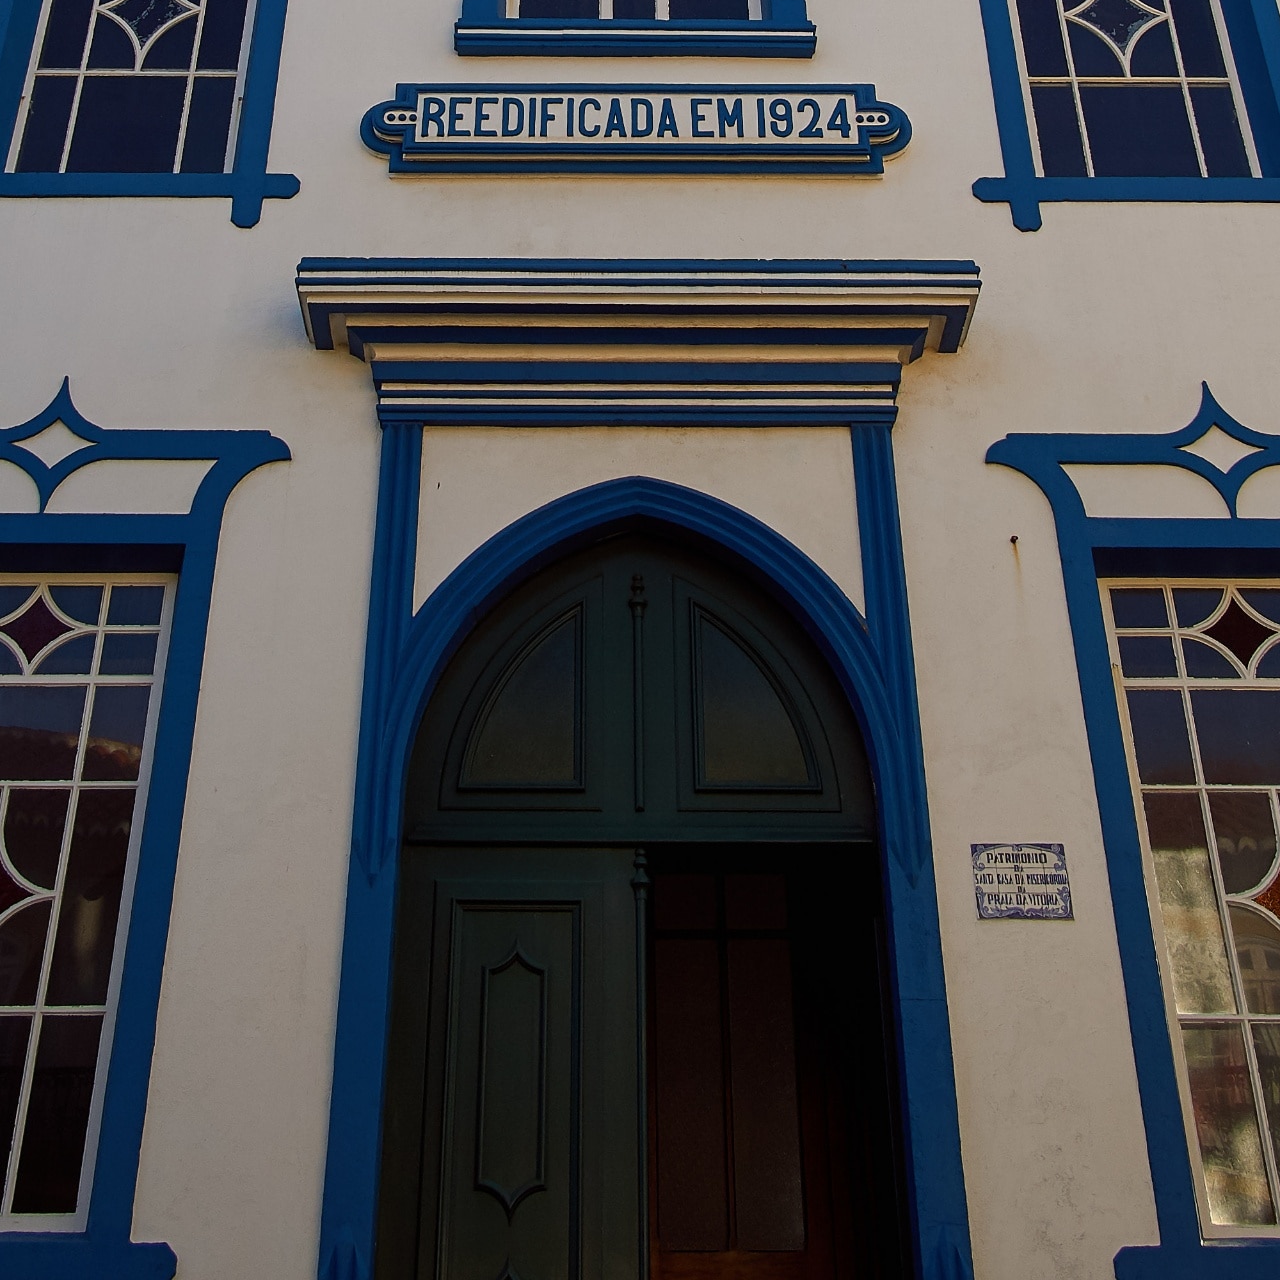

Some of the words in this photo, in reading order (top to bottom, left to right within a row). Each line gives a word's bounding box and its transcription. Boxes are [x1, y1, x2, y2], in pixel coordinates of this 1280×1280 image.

[421, 96, 681, 138] REEDIFICADA
[692, 97, 746, 138] EM
[757, 97, 852, 138] 1924
[997, 873, 1014, 885] CASA
[1014, 873, 1026, 885] DA
[987, 893, 1014, 905] PRAIA
[1016, 893, 1029, 905] DA
